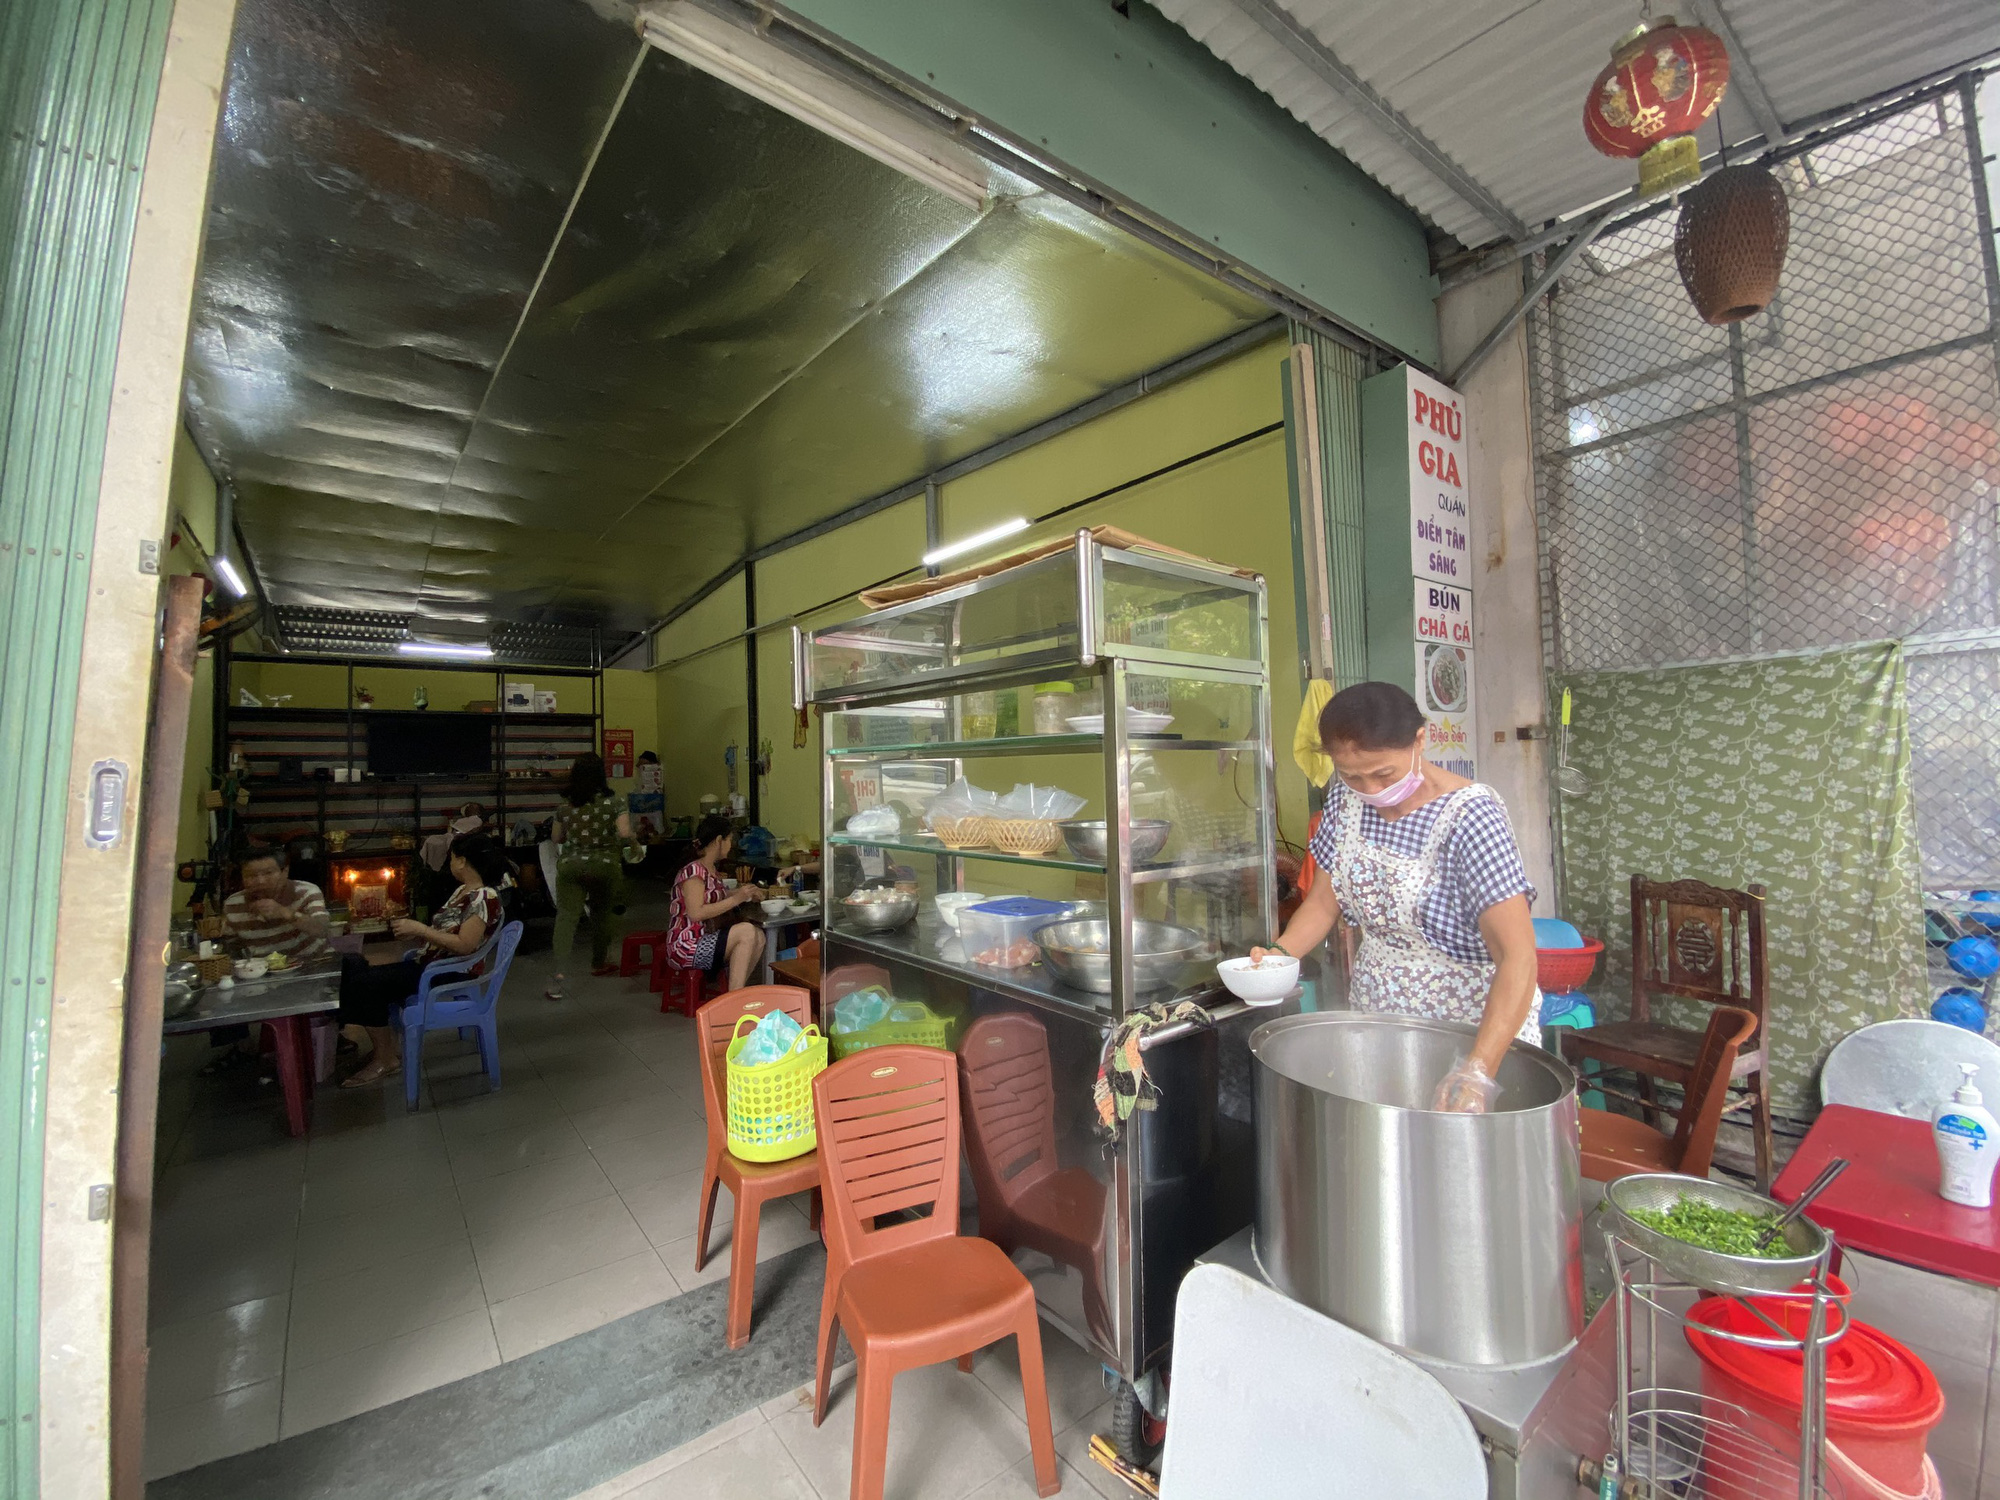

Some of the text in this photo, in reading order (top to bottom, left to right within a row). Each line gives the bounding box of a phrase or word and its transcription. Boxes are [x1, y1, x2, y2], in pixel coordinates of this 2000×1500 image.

[1418, 440, 1462, 488] GIA
[1438, 493, 1466, 517] QUÁN
[1417, 514, 1466, 552] ĐIỂM TÂM
[1429, 549, 1457, 577] SÁNG
[1429, 586, 1461, 612] BÚN
[1418, 614, 1471, 643] CHẢ CÁ
[1429, 723, 1468, 746] Đặc Sản
